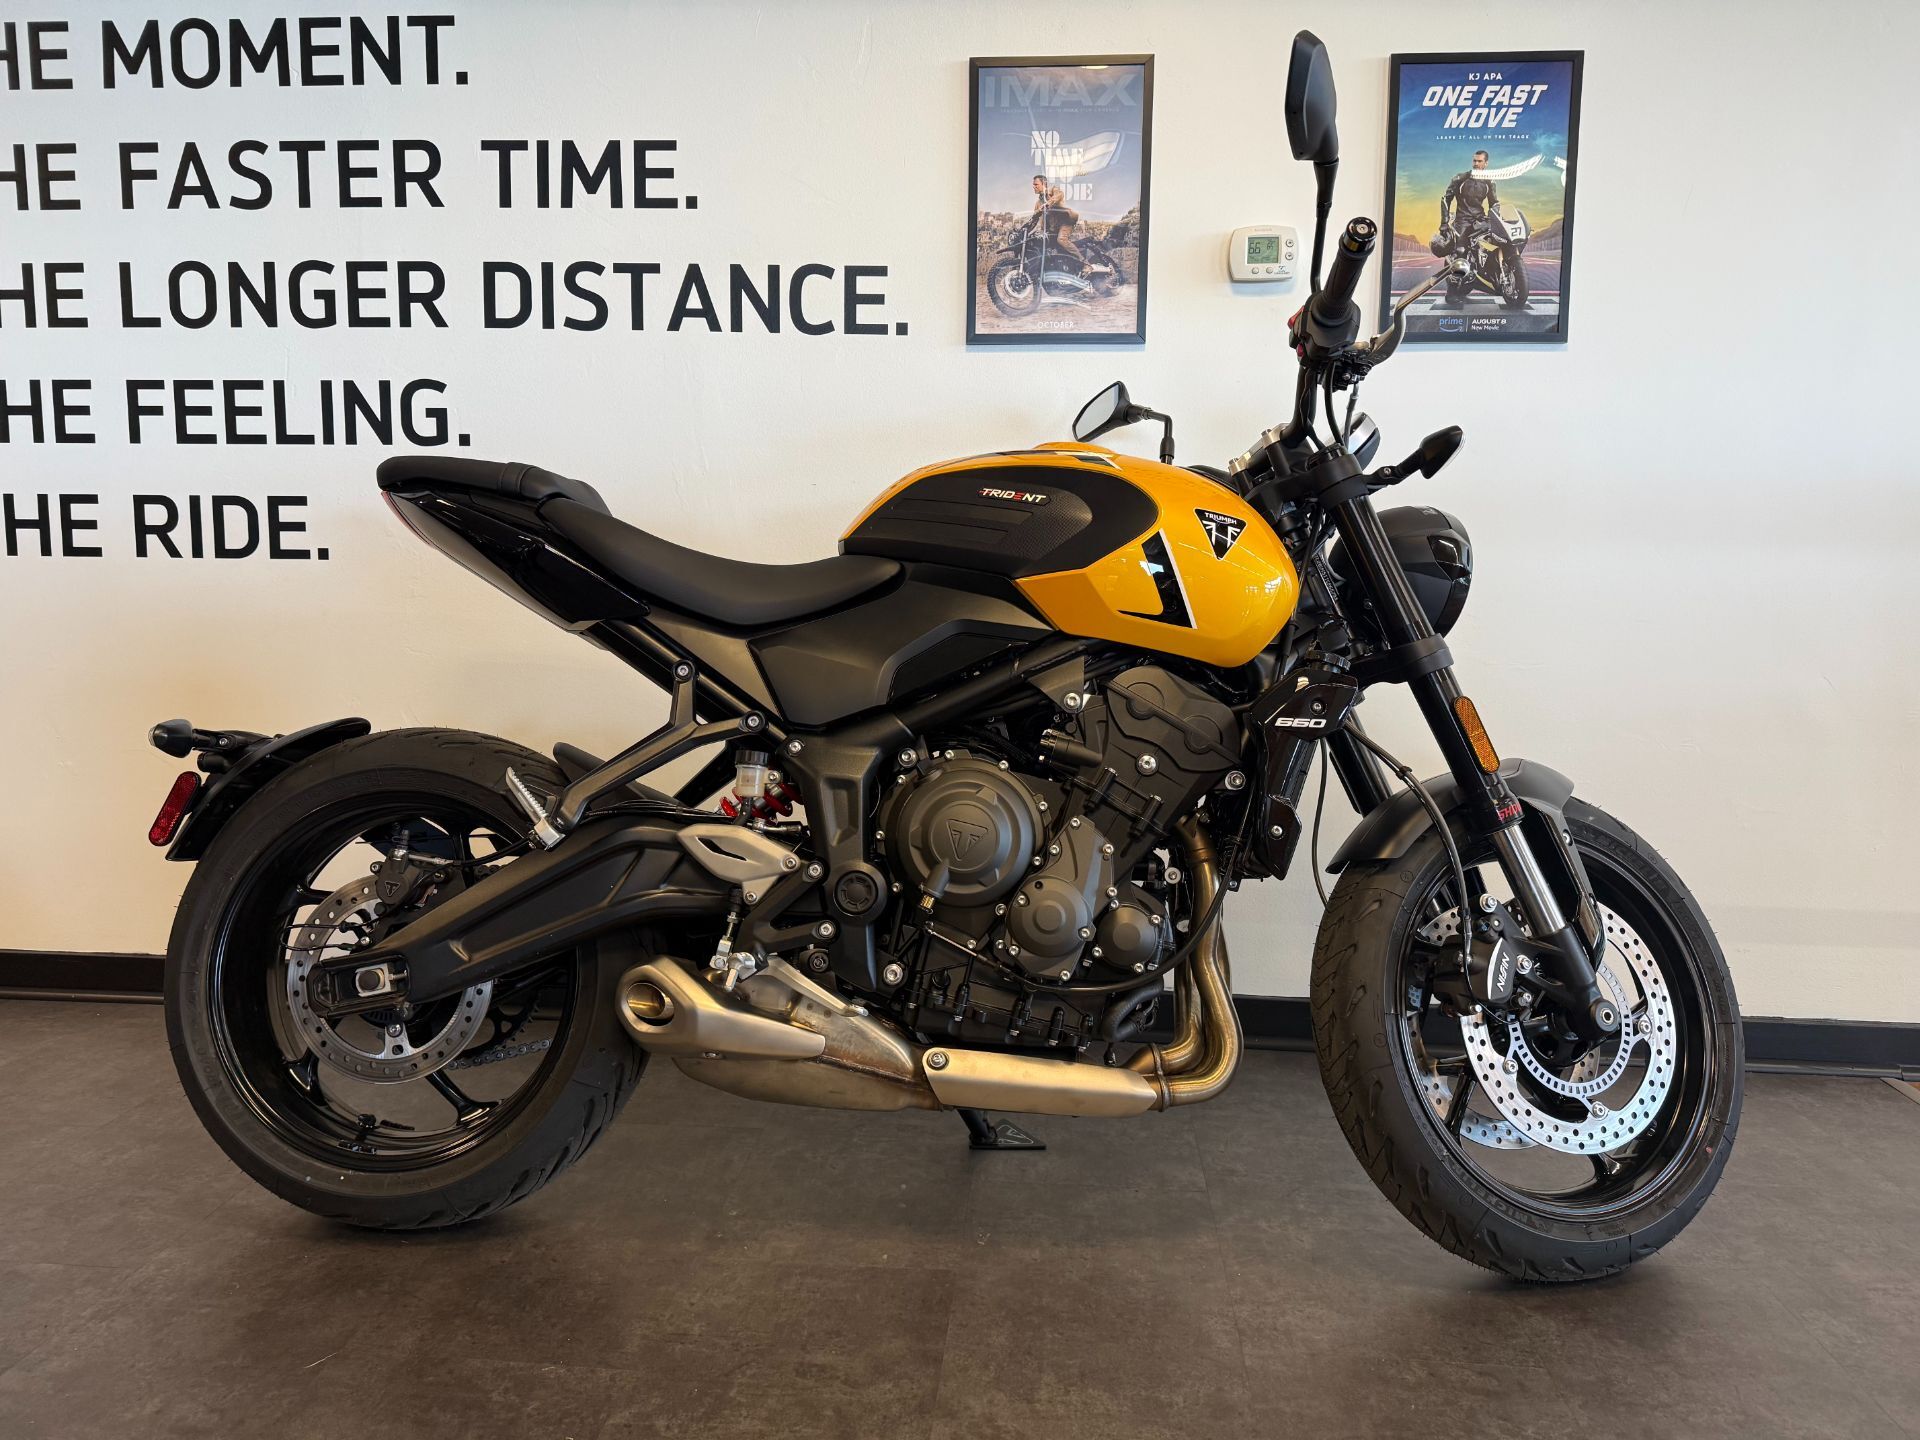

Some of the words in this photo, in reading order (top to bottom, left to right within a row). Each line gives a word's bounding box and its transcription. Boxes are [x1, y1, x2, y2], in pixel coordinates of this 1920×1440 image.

[102, 16, 469, 89] MOMENT.
[1469, 73, 1480, 81] KJ
[1483, 72, 1503, 80] APA
[984, 74, 1137, 107] IMAX
[1422, 85, 1479, 107] ONE
[1479, 84, 1549, 106] FAST
[1443, 107, 1524, 129] MOVE
[1031, 130, 1060, 148] NO
[118, 140, 445, 210] FASTER
[481, 139, 698, 209] TIME.
[1060, 183, 1093, 200] DIE
[1510, 227, 1522, 237] 27
[119, 260, 449, 329] LONGER
[483, 261, 908, 336] DISTANCE.
[1037, 320, 1075, 329] OCTOBER
[1439, 316, 1464, 326] prime
[126, 378, 471, 447] FEELING.
[980, 487, 1047, 503] TRIDENT
[1204, 511, 1238, 525] TRIUMPH
[133, 494, 330, 561] RIDE.
[1274, 717, 1328, 729] 660
